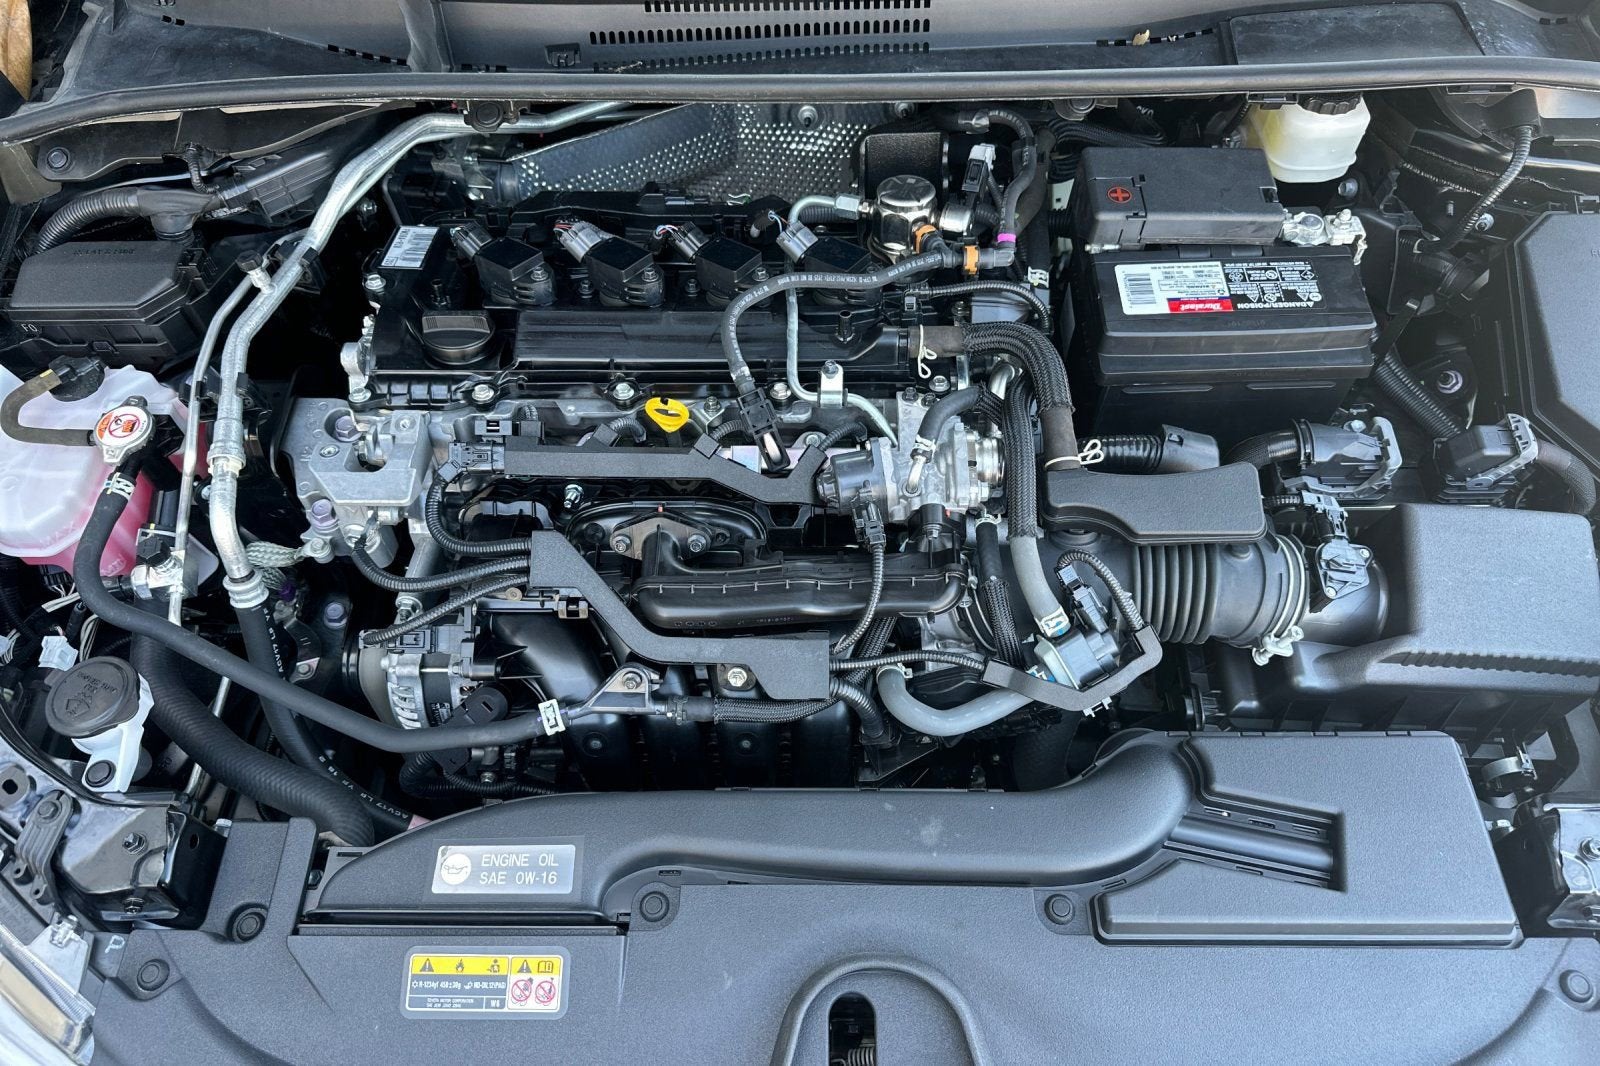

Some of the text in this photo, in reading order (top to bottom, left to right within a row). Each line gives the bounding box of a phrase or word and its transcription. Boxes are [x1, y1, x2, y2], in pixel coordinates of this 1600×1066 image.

[1179, 302, 1223, 311] Duralast
[481, 853, 559, 867] ENGINE OIL
[479, 871, 557, 885] SAE 0W-16
[105, 934, 126, 954] P
